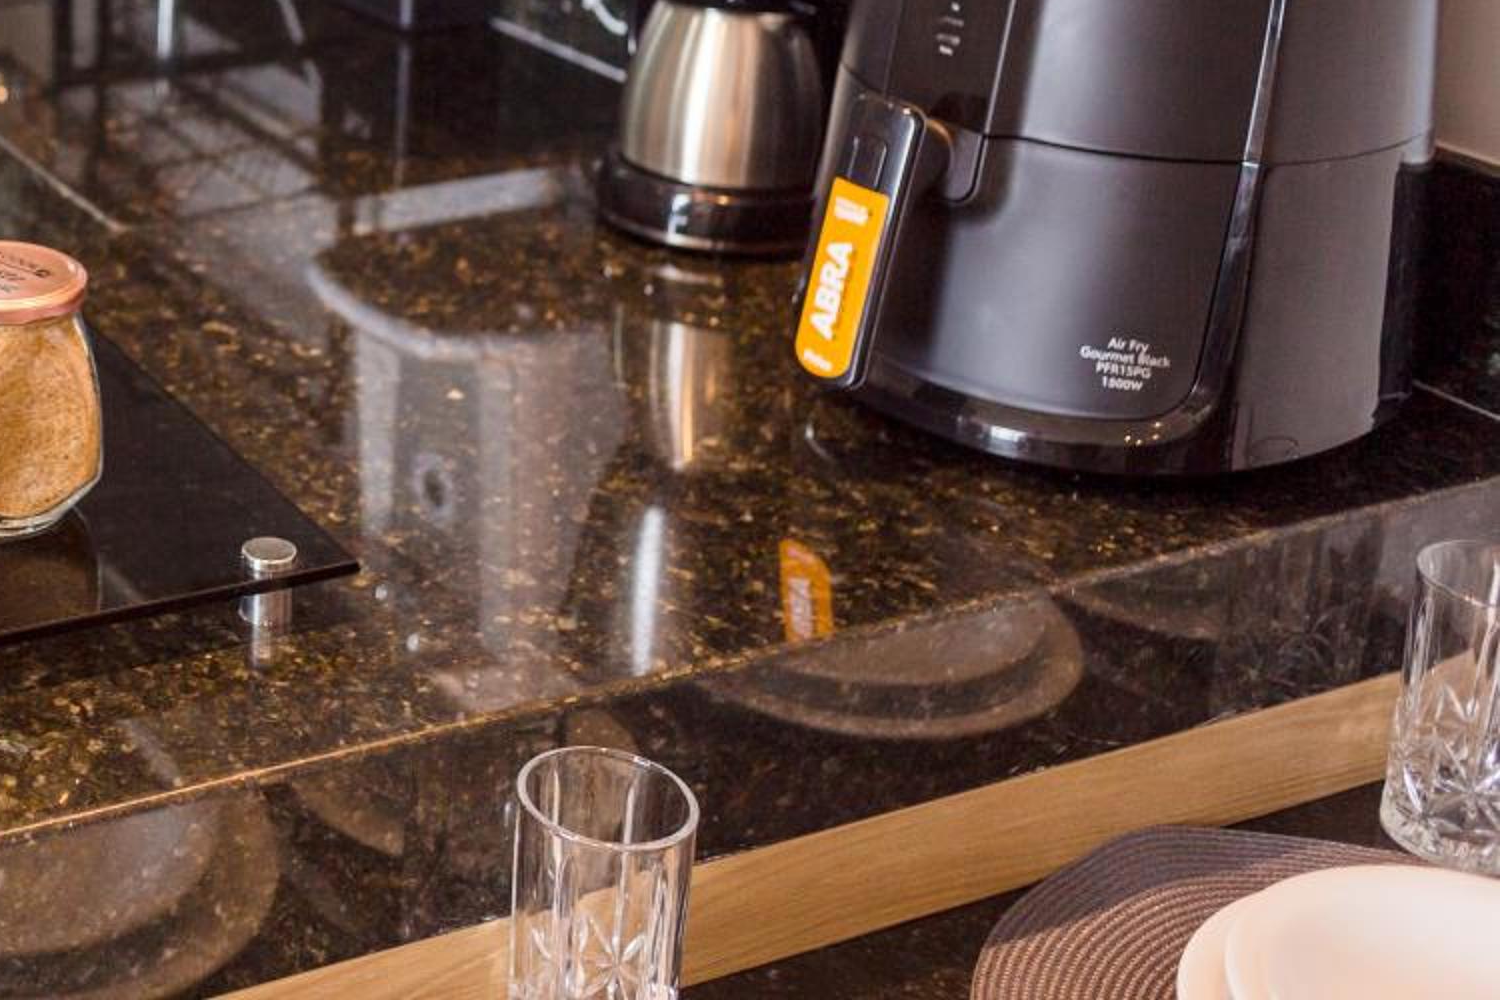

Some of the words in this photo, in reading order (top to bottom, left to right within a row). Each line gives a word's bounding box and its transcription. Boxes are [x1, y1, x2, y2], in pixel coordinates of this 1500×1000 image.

[810, 242, 853, 340] ABRA
[1079, 345, 1135, 364] Gourmet
[1138, 351, 1170, 368] Black
[1108, 338, 1126, 350] Air
[1129, 339, 1150, 353] Fry
